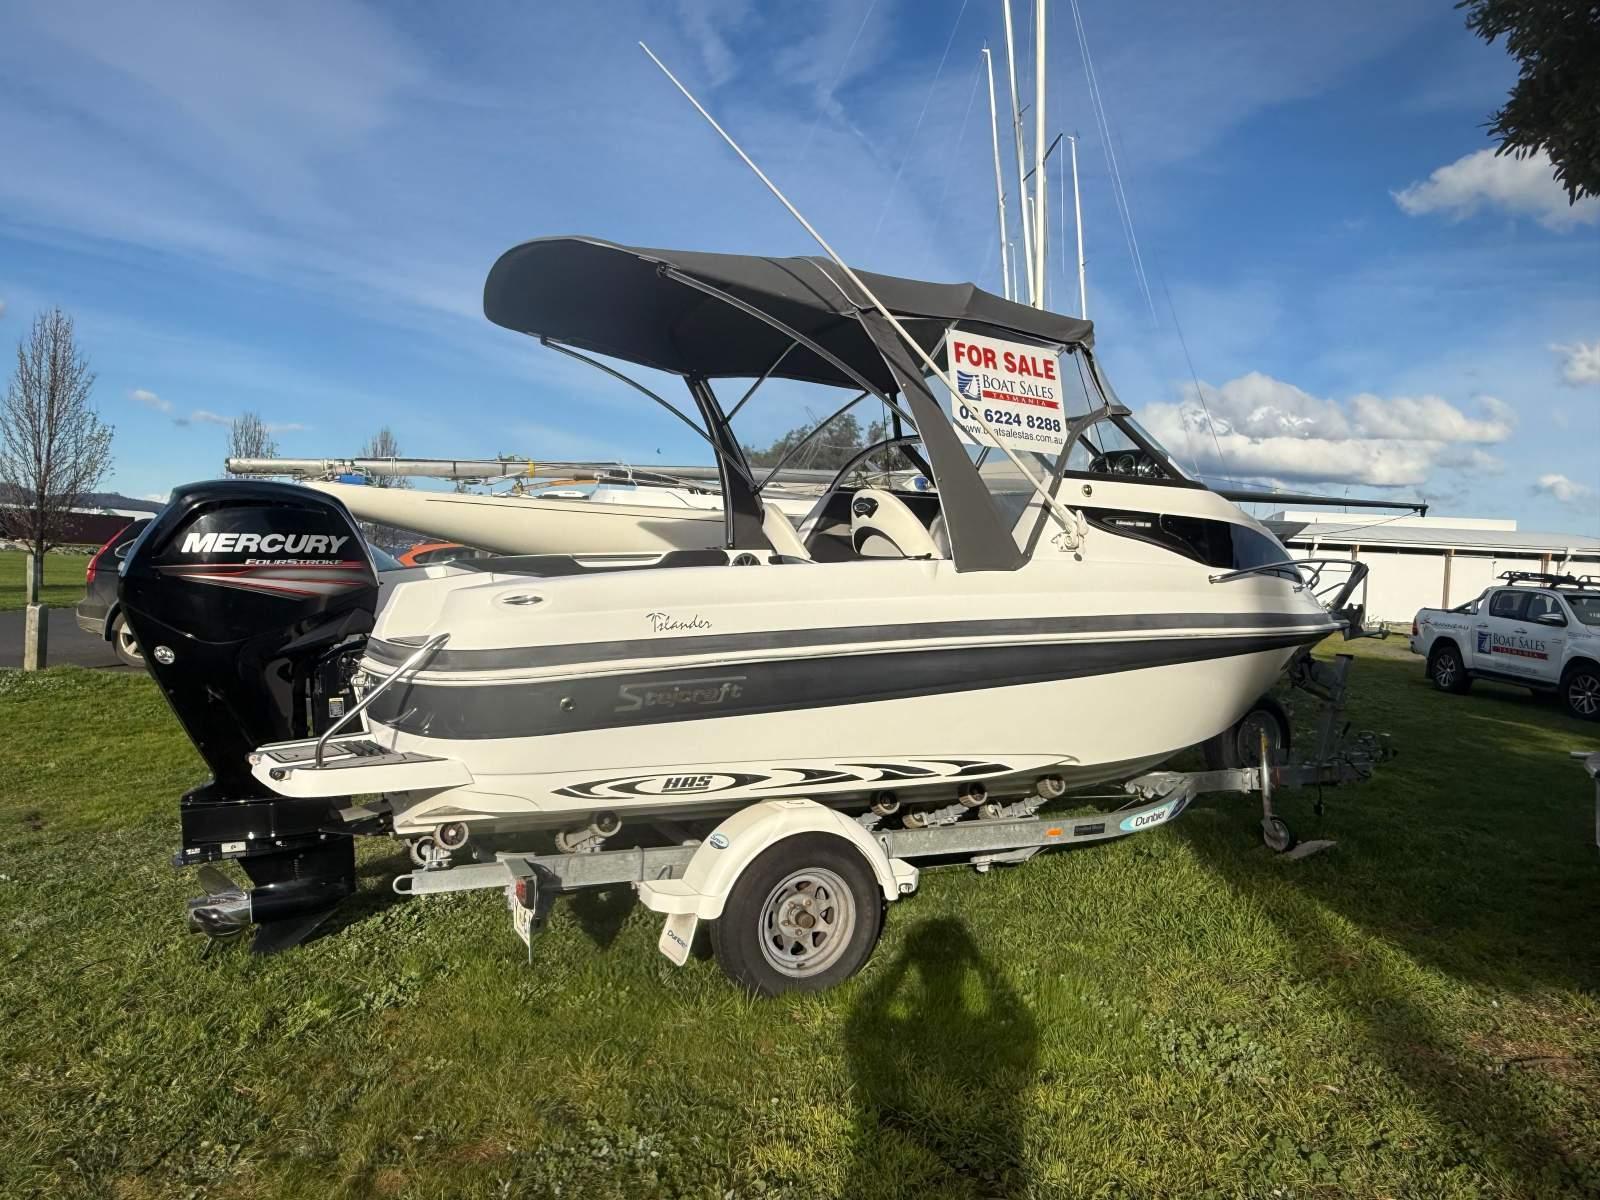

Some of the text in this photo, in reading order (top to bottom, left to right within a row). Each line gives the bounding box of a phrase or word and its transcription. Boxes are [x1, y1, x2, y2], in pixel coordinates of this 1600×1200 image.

[954, 341, 1056, 380] FOR SALE
[982, 374, 1054, 400] BOAT SALES
[991, 392, 1047, 406] TASMANIA
[984, 408, 1022, 427] 6224
[1026, 414, 1061, 433] 8288
[181, 532, 349, 554] MERCURY
[645, 612, 713, 633] Islander
[1493, 632, 1545, 652] BOAT SALES
